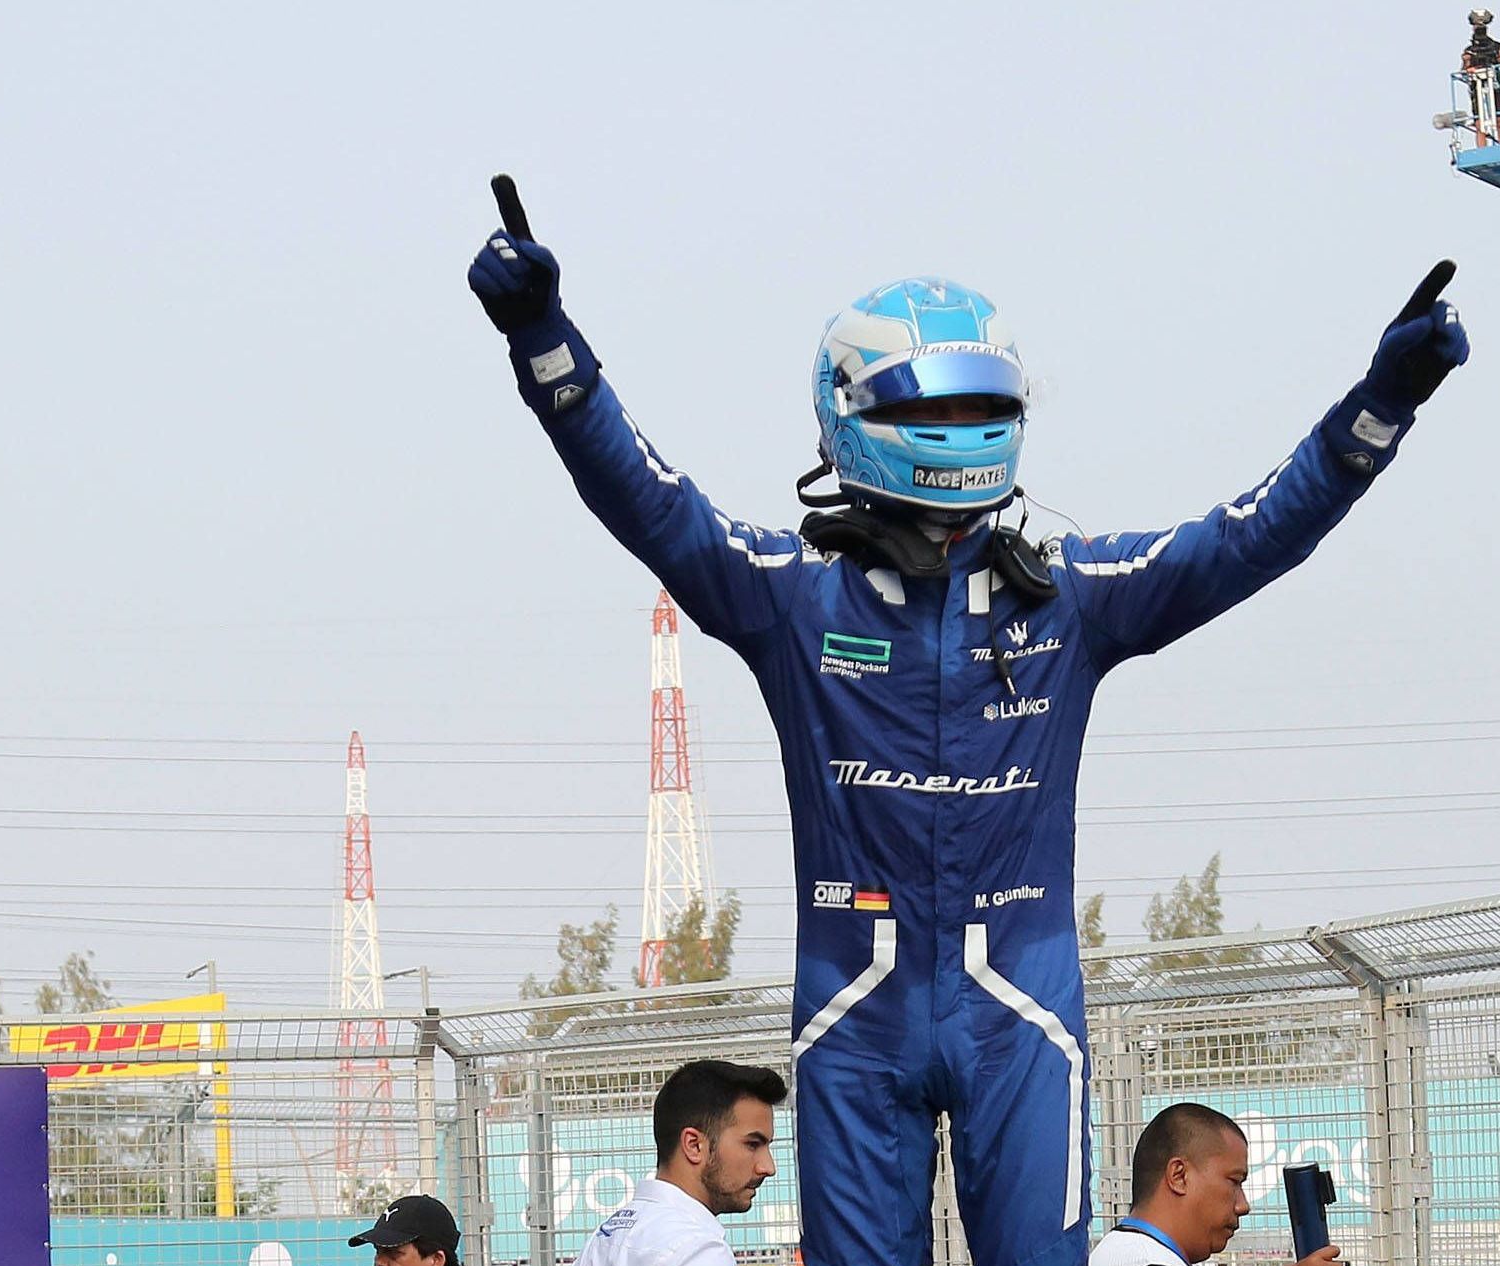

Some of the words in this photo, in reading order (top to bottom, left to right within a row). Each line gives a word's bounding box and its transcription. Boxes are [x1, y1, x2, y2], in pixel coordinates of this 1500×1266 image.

[820, 664, 862, 679] Enterprise
[821, 655, 854, 669] Hewlett
[855, 660, 889, 674] Packard
[1000, 697, 1050, 719] Lukka
[828, 759, 1039, 795] Maserati
[814, 885, 851, 904] OMP
